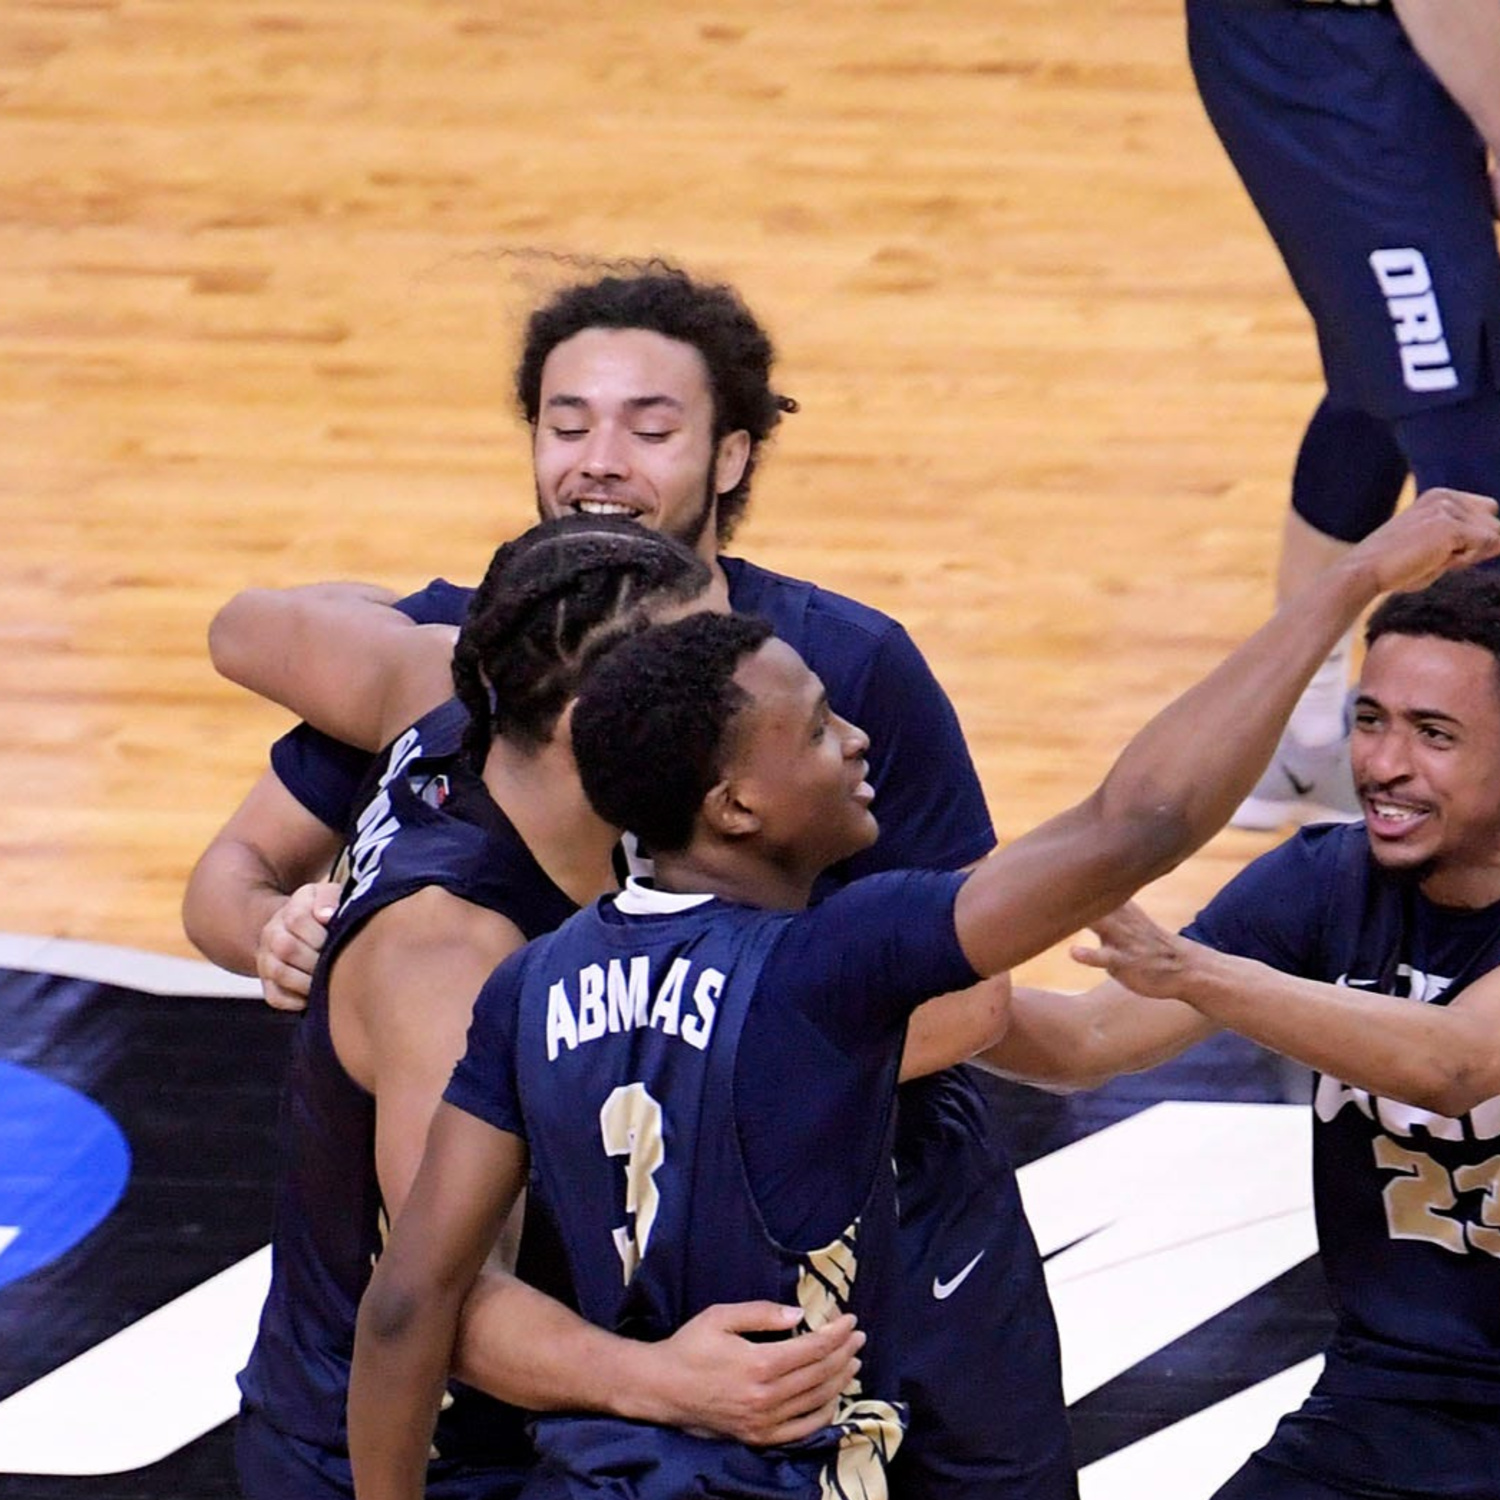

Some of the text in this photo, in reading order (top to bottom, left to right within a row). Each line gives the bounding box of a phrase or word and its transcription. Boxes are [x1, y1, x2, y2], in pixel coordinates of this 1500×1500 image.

[1368, 247, 1459, 392] ORU
[547, 955, 726, 1062] ABMAS
[600, 1082, 664, 1287] 3
